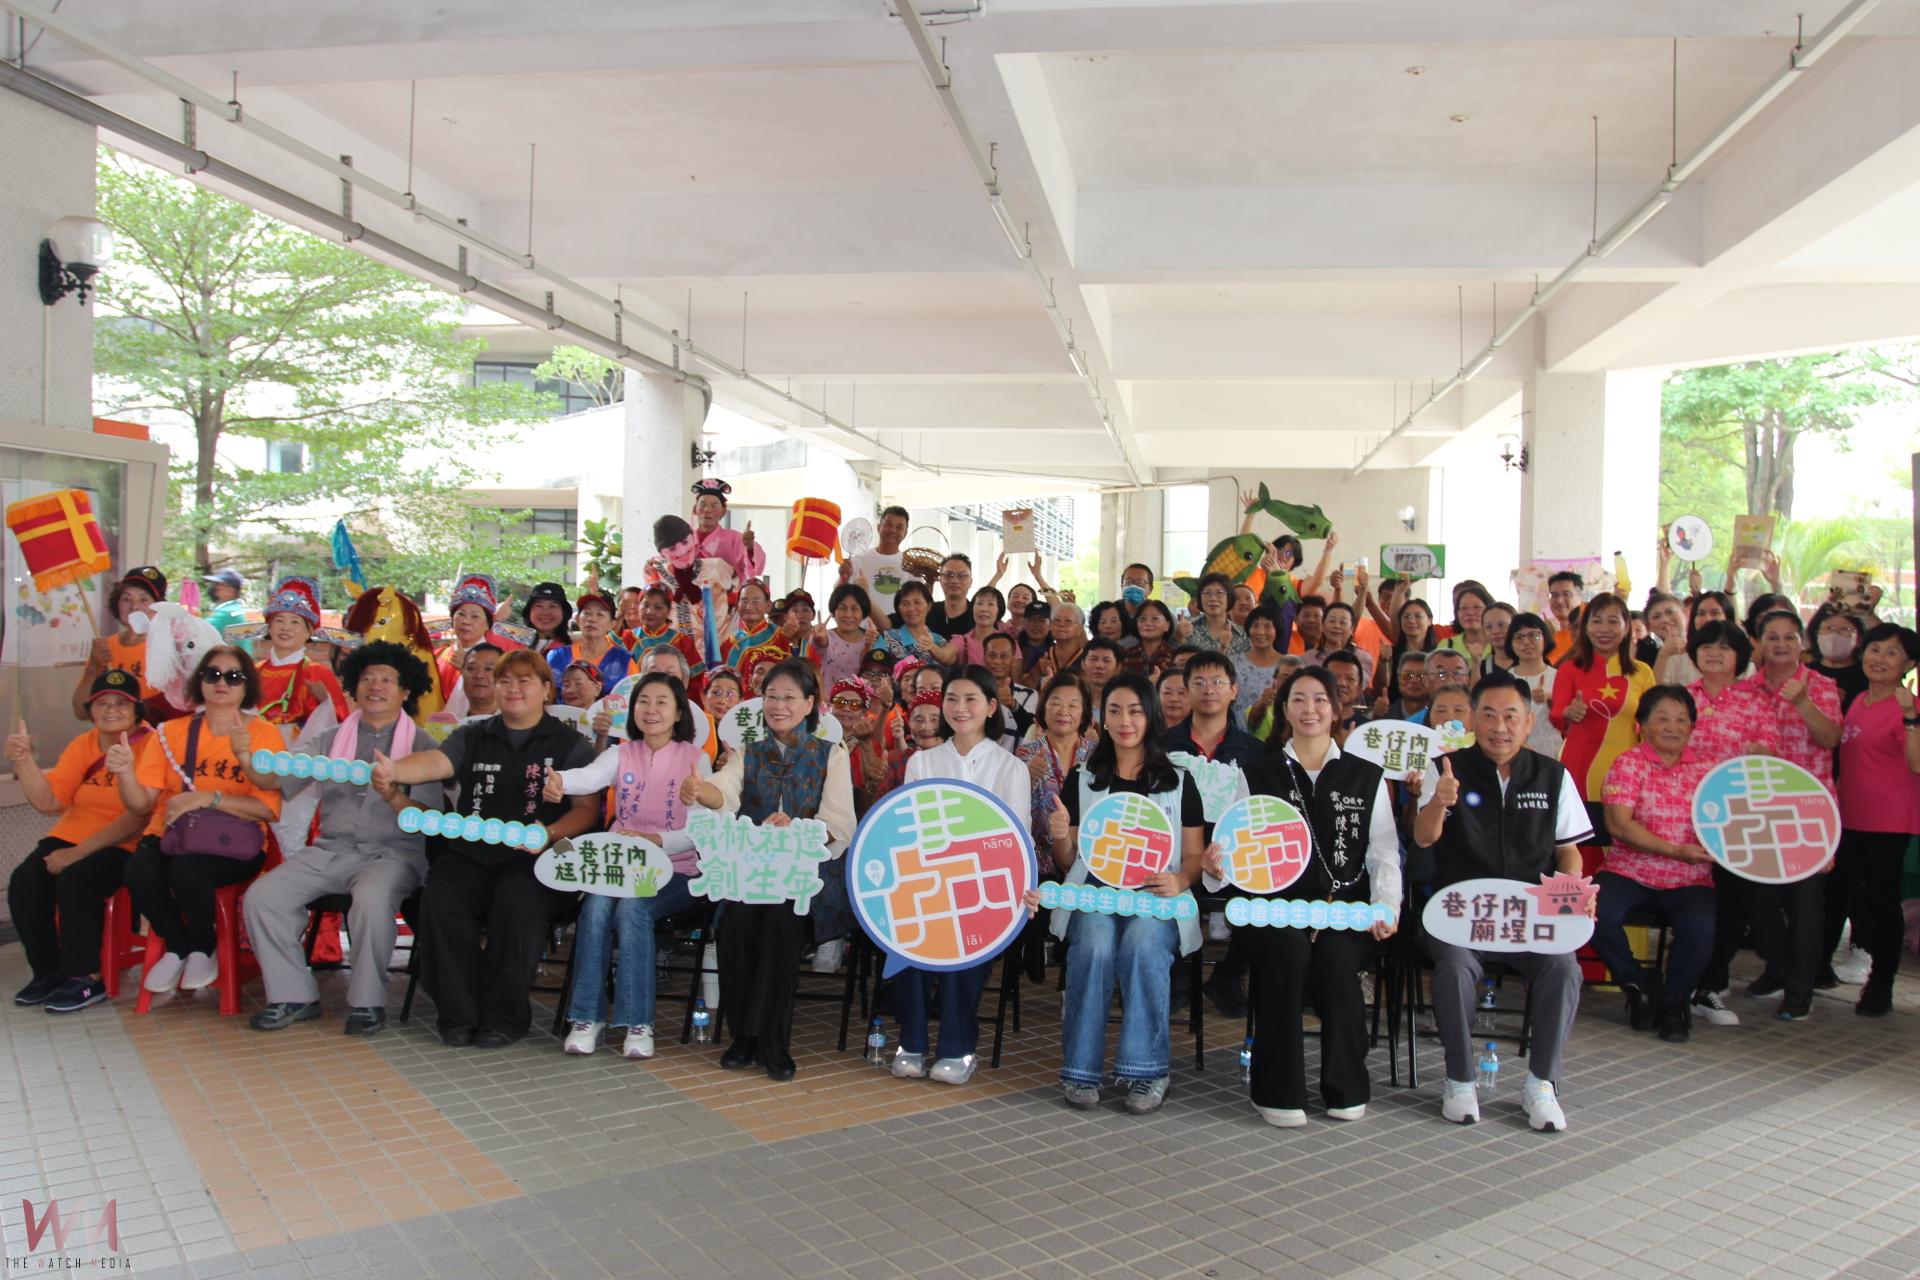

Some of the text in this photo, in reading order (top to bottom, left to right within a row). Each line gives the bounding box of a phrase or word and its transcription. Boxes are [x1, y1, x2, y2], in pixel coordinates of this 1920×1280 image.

[1364, 727, 1429, 753] 巷仔內
[254, 754, 367, 780] 山海平原協奏
[1383, 751, 1426, 772] 逗陣
[401, 811, 542, 846] 山海平原協奏曲
[687, 813, 827, 860] 雲林社造
[579, 840, 647, 867] 巷仔內
[692, 855, 820, 913] 創生年
[1040, 887, 1191, 918] 社造共生創生不息
[1441, 891, 1528, 918] 巷仔內
[1469, 917, 1555, 944] 廟埕口
